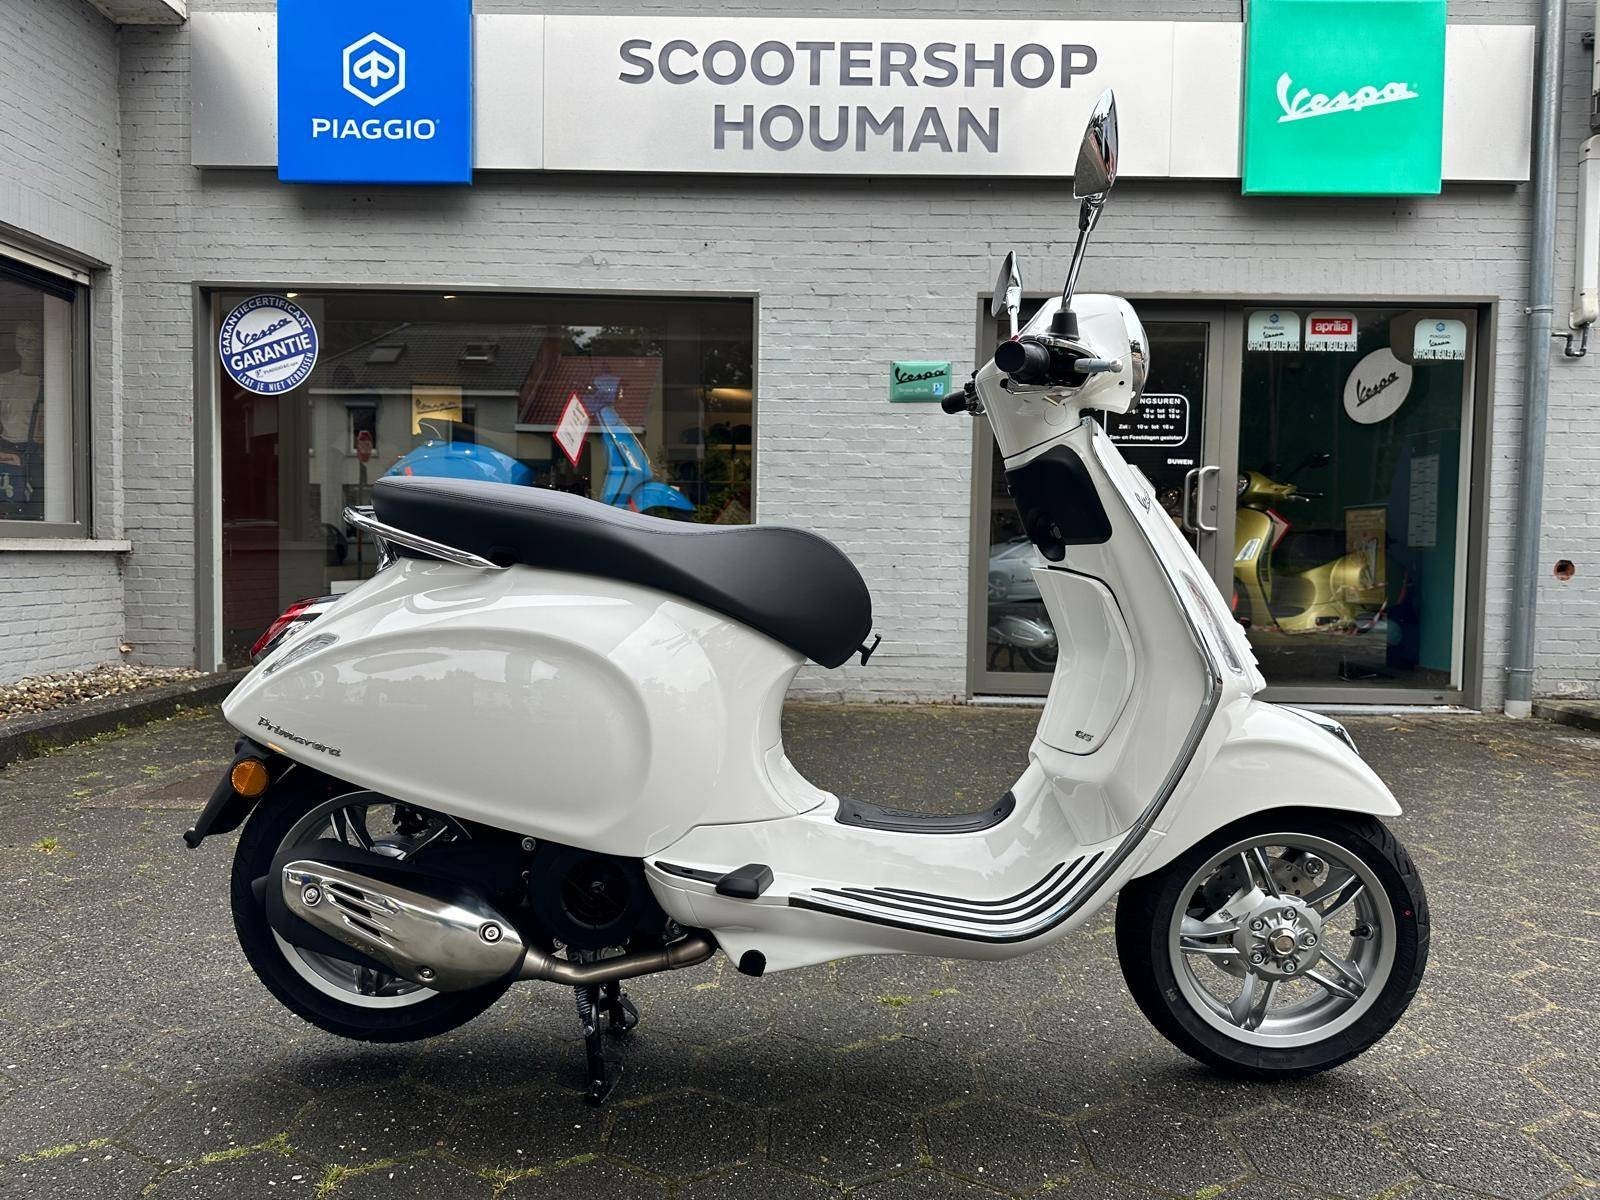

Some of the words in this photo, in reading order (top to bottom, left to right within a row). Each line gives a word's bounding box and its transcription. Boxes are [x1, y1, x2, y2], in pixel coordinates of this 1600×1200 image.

[618, 38, 1098, 89] SCOOTERSHOP
[1276, 71, 1419, 123] Vespa
[311, 118, 436, 140] PIAGGIO
[713, 103, 1000, 153] HOUMAN
[222, 297, 311, 355] GARANTIECERTIFICAAT
[235, 318, 293, 350] Vespa
[1315, 320, 1349, 333] aprilia
[230, 333, 313, 371] GARANTIE
[236, 372, 254, 387] LAAT
[255, 382, 265, 391] JE
[268, 382, 286, 392] NIET
[287, 352, 315, 387] VERRASSEN
[894, 366, 948, 386] Vespa
[1356, 371, 1400, 408] Vespa
[257, 715, 342, 758] Primavera
